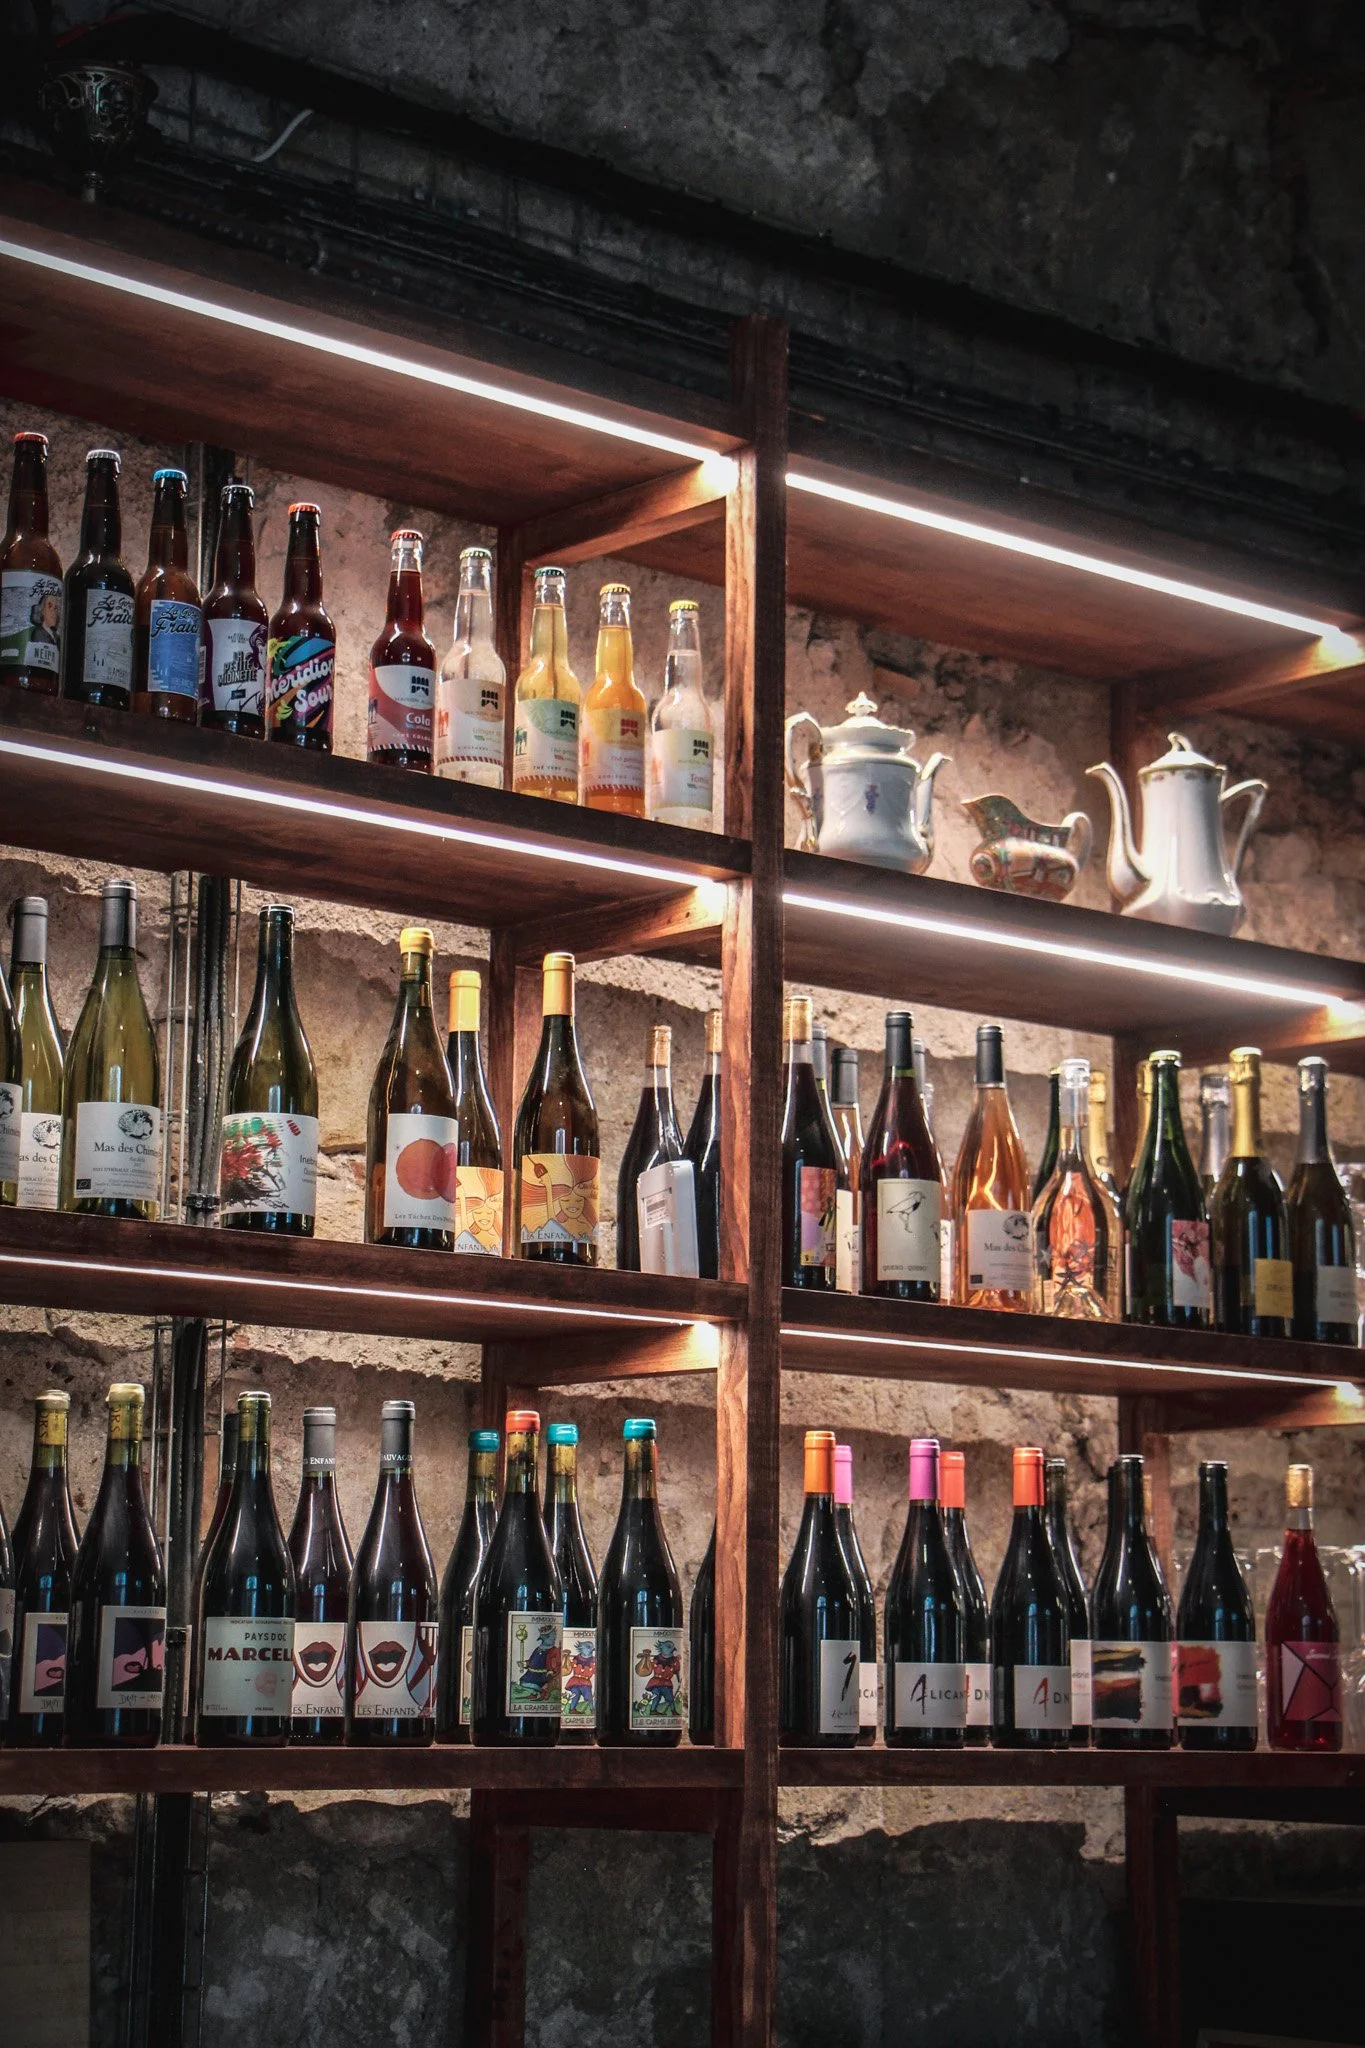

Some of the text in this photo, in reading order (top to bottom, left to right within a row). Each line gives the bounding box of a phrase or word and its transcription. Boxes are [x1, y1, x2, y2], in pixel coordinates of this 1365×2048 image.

[406, 712, 431, 727] Cola
[94, 1141, 116, 1153] Mas
[117, 1142, 134, 1153] des
[32, 1152, 48, 1163] des
[244, 1632, 288, 1641] PAYS D'OC
[357, 1704, 372, 1716] LES
[374, 1704, 416, 1716] ENFANTS
